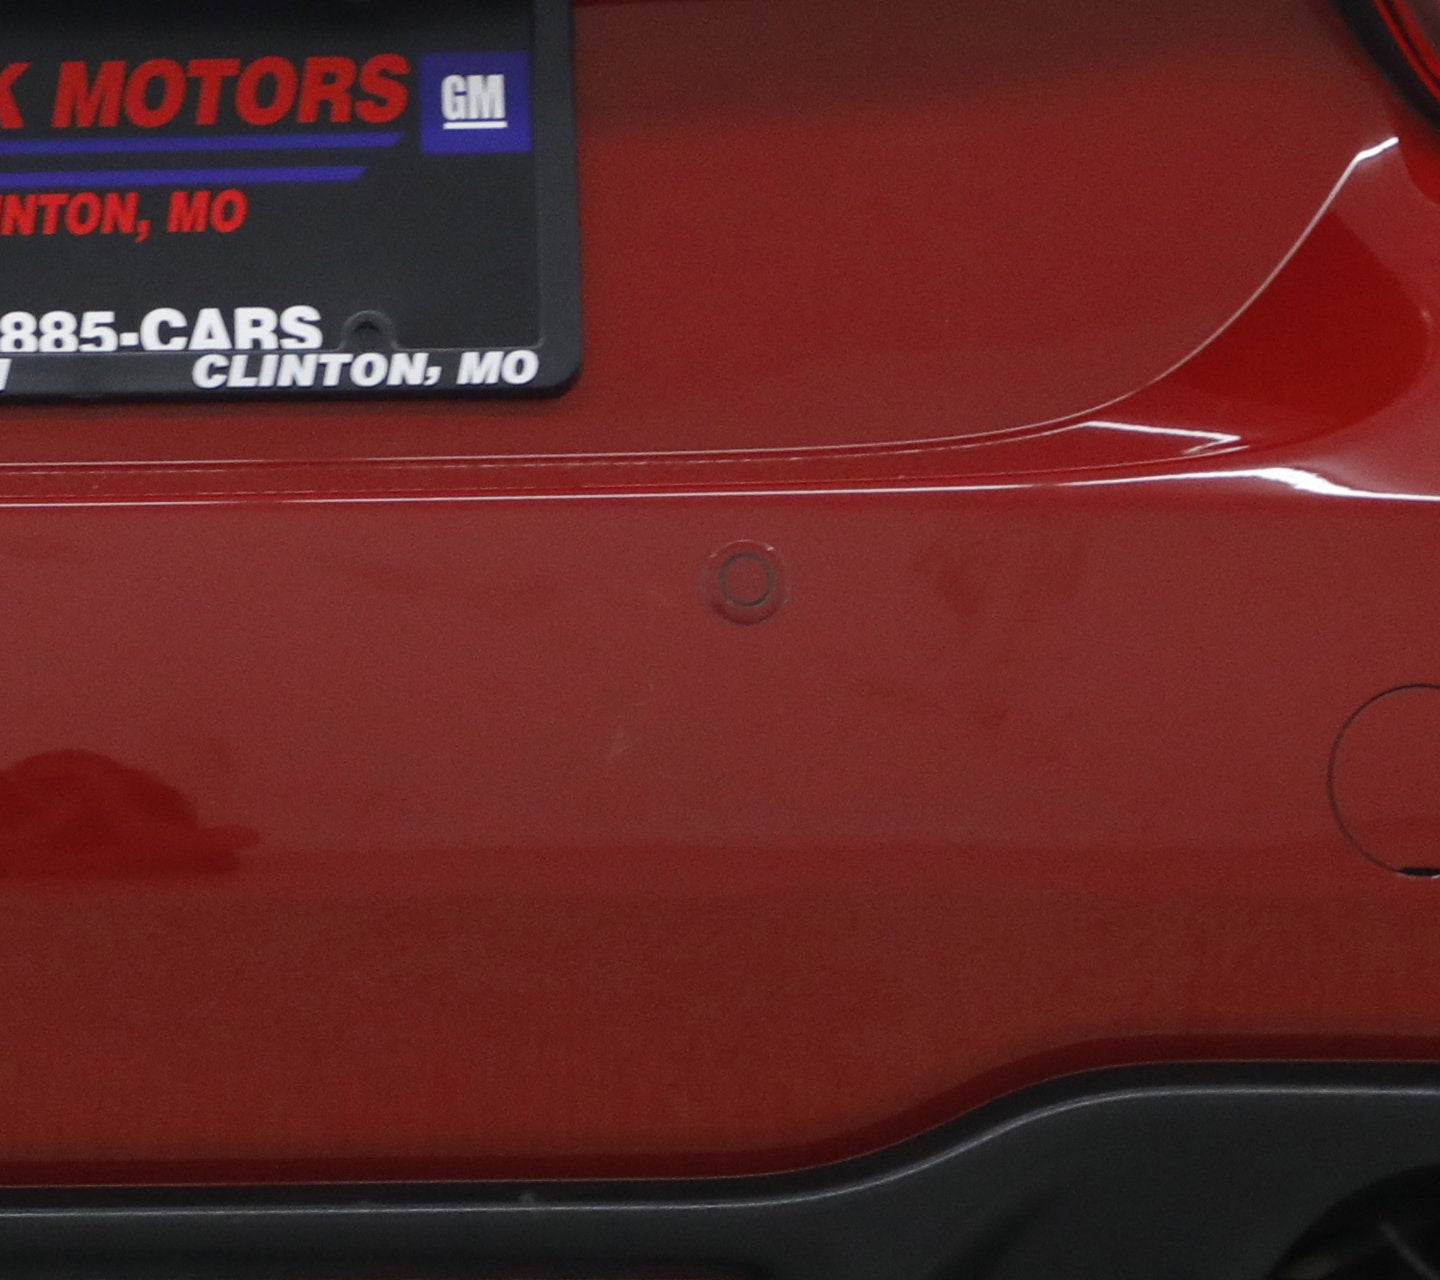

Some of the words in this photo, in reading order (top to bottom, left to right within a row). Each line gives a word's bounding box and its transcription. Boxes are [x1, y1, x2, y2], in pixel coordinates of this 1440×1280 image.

[52, 53, 410, 128] MOTORS
[440, 73, 506, 120] GM
[166, 188, 248, 234] MO
[187, 351, 443, 389] CLINTON,
[455, 349, 540, 385] MO
